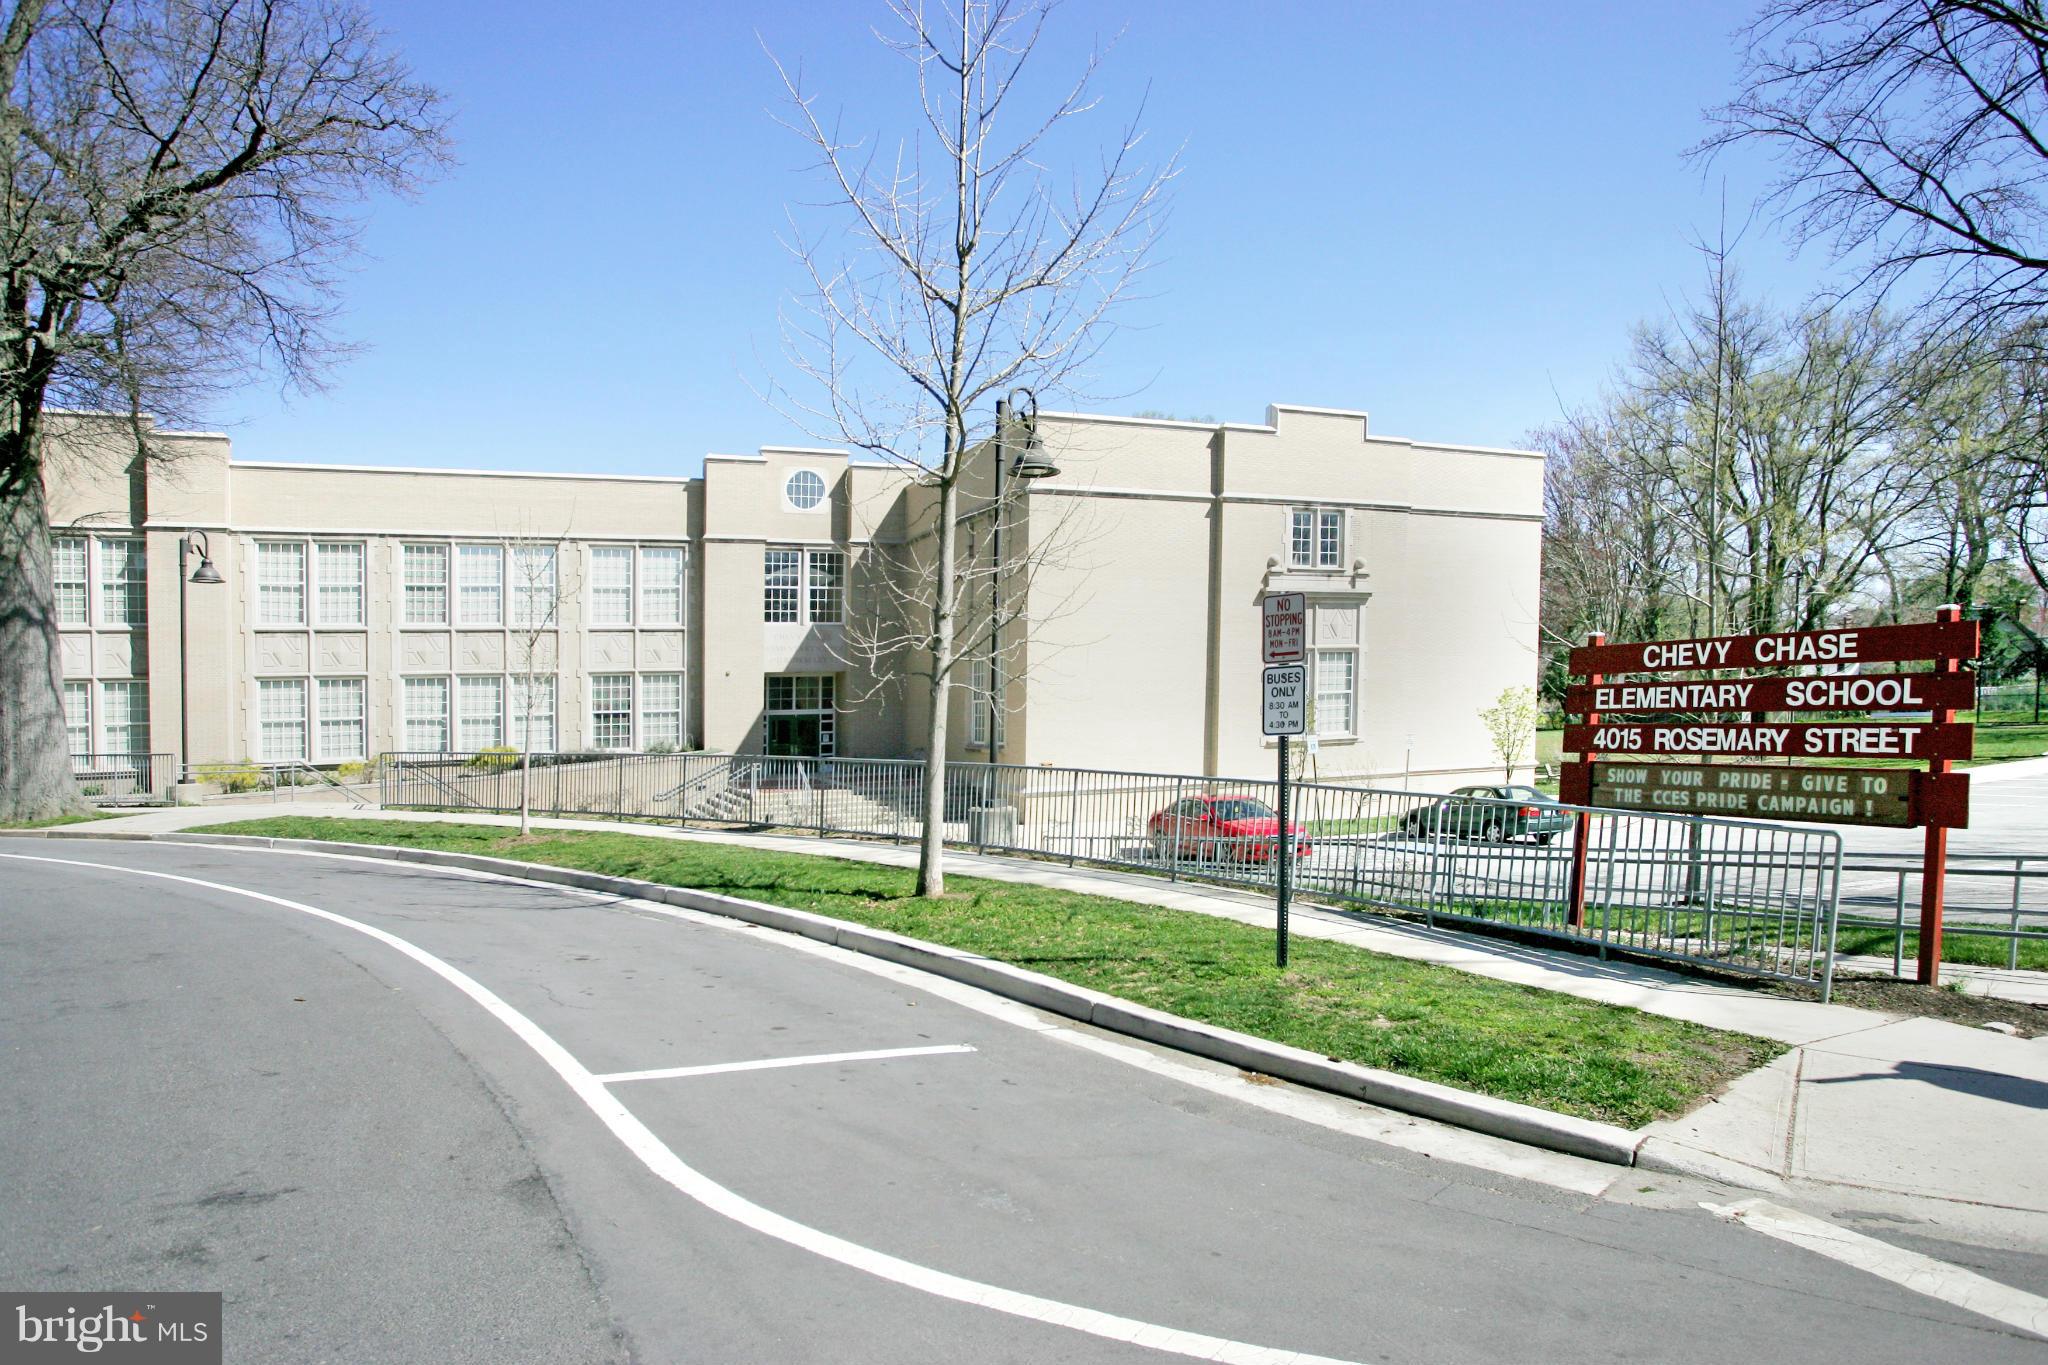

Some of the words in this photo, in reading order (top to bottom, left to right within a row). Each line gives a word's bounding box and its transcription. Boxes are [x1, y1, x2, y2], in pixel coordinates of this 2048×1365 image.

[1277, 599, 1291, 611] NO
[1265, 612, 1303, 628] STOPPING
[1643, 641, 1731, 668] CHEVY
[1755, 633, 1858, 661] CHASE
[1267, 672, 1301, 685] BUSES
[1271, 686, 1297, 698] ONLY
[1595, 684, 1753, 710] ELEMENTARY
[1786, 678, 1923, 706] SCHOOL
[1269, 702, 1284, 710] 8:30
[1288, 720, 1298, 728] PM
[1593, 728, 1642, 750] 4015
[1654, 728, 1790, 752] ROSEMARY
[1804, 727, 1921, 754] STREET
[1607, 768, 1648, 784] SHOW
[1661, 770, 1703, 787] YOUR
[1719, 773, 1772, 790] PRIDE
[1801, 775, 1848, 793] GIVE
[1861, 776, 1888, 795] TO
[1615, 788, 1642, 804] THE
[1652, 789, 1690, 806] CCES
[1696, 793, 1748, 810] PRIDE
[1757, 794, 1855, 817] CAMPAIGN
